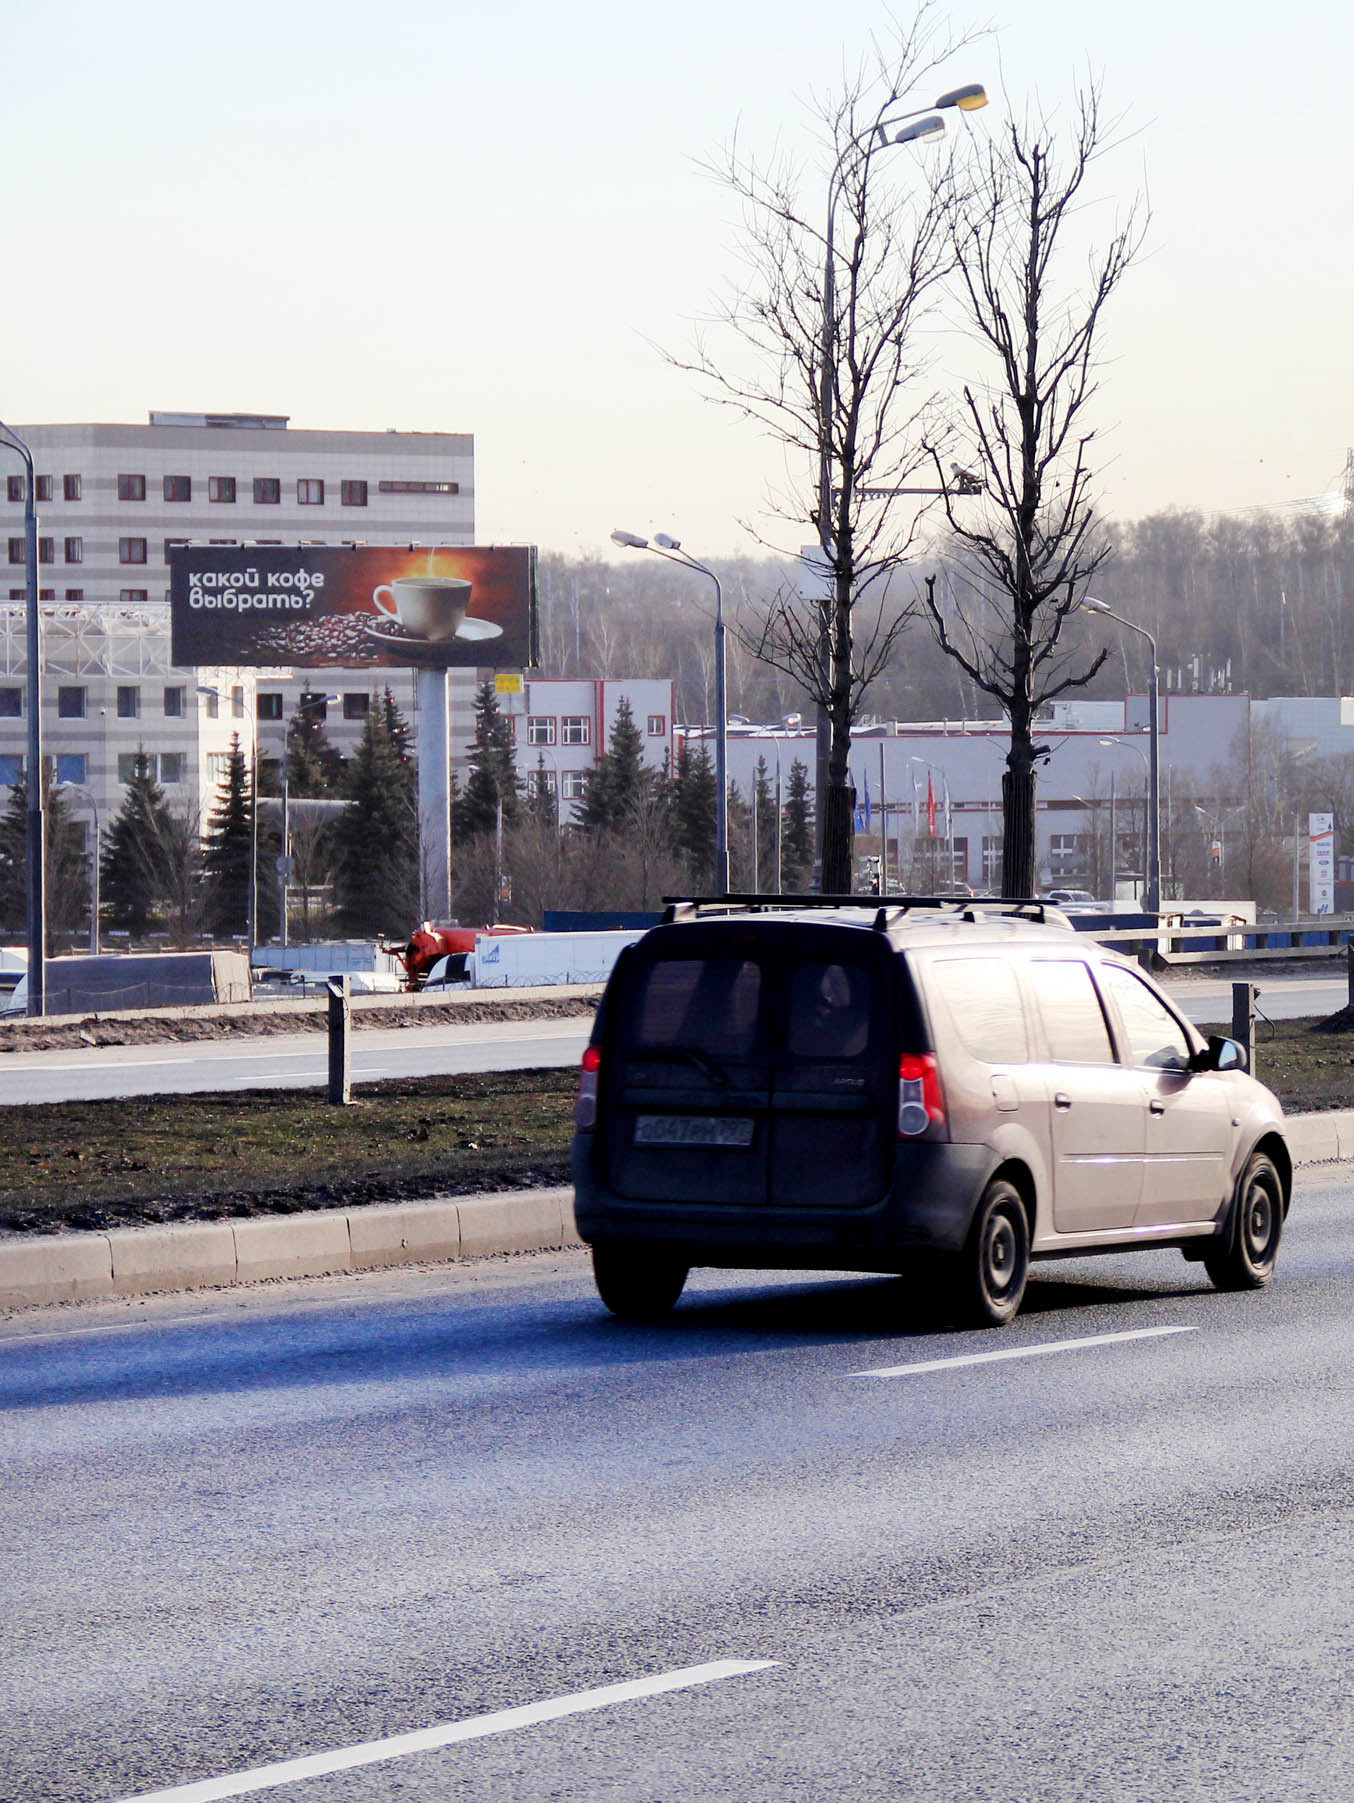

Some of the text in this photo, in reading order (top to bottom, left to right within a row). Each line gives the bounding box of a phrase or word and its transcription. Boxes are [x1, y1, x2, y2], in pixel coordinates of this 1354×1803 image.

[189, 568, 325, 591] какой кофе
[189, 587, 315, 612] выбрать?
